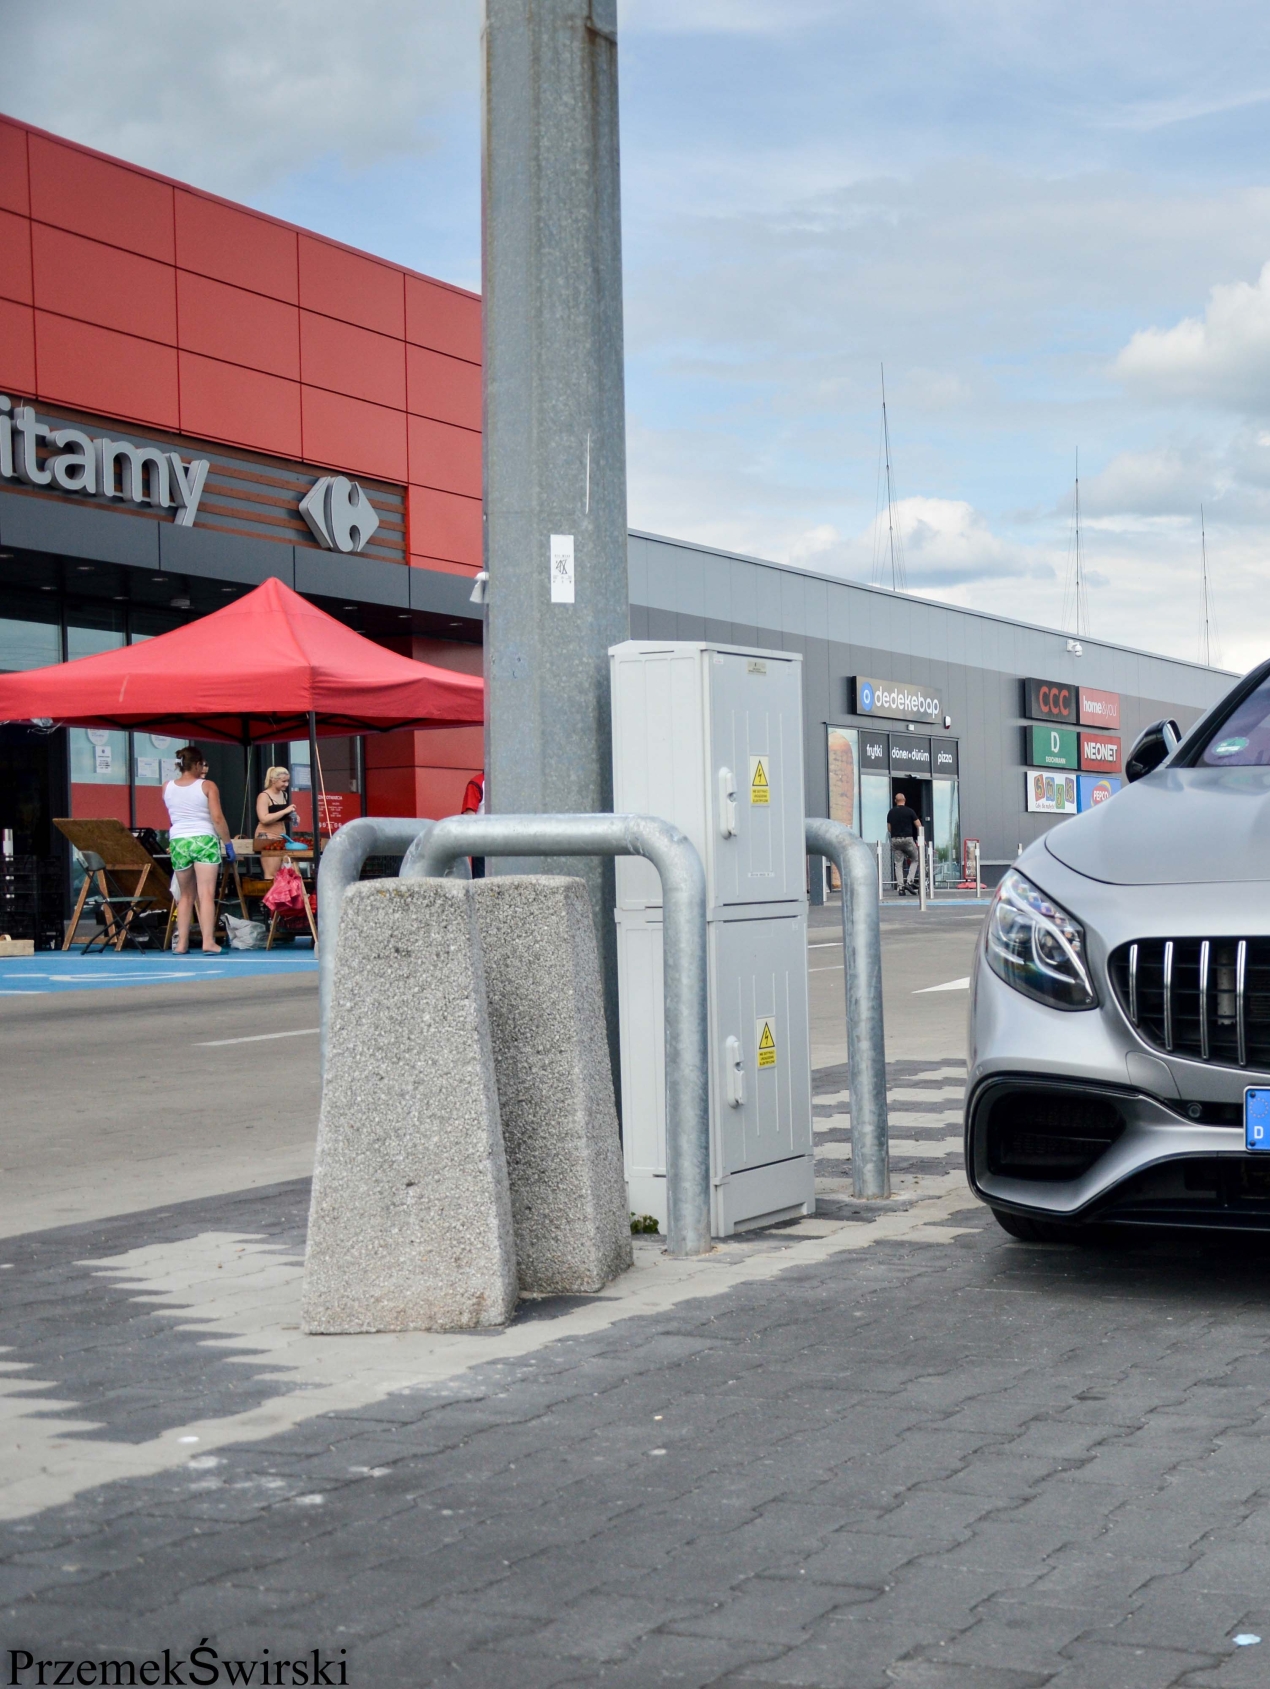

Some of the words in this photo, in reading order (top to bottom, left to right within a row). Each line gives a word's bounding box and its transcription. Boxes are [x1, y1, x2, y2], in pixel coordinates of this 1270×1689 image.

[874, 685, 940, 718] dedekebap
[1039, 685, 1069, 716] CCC
[866, 743, 883, 760] frytki
[1050, 731, 1060, 753] D
[1084, 741, 1118, 762] NEONET
[937, 751, 953, 765] pizza
[1254, 1125, 1264, 1139] D
